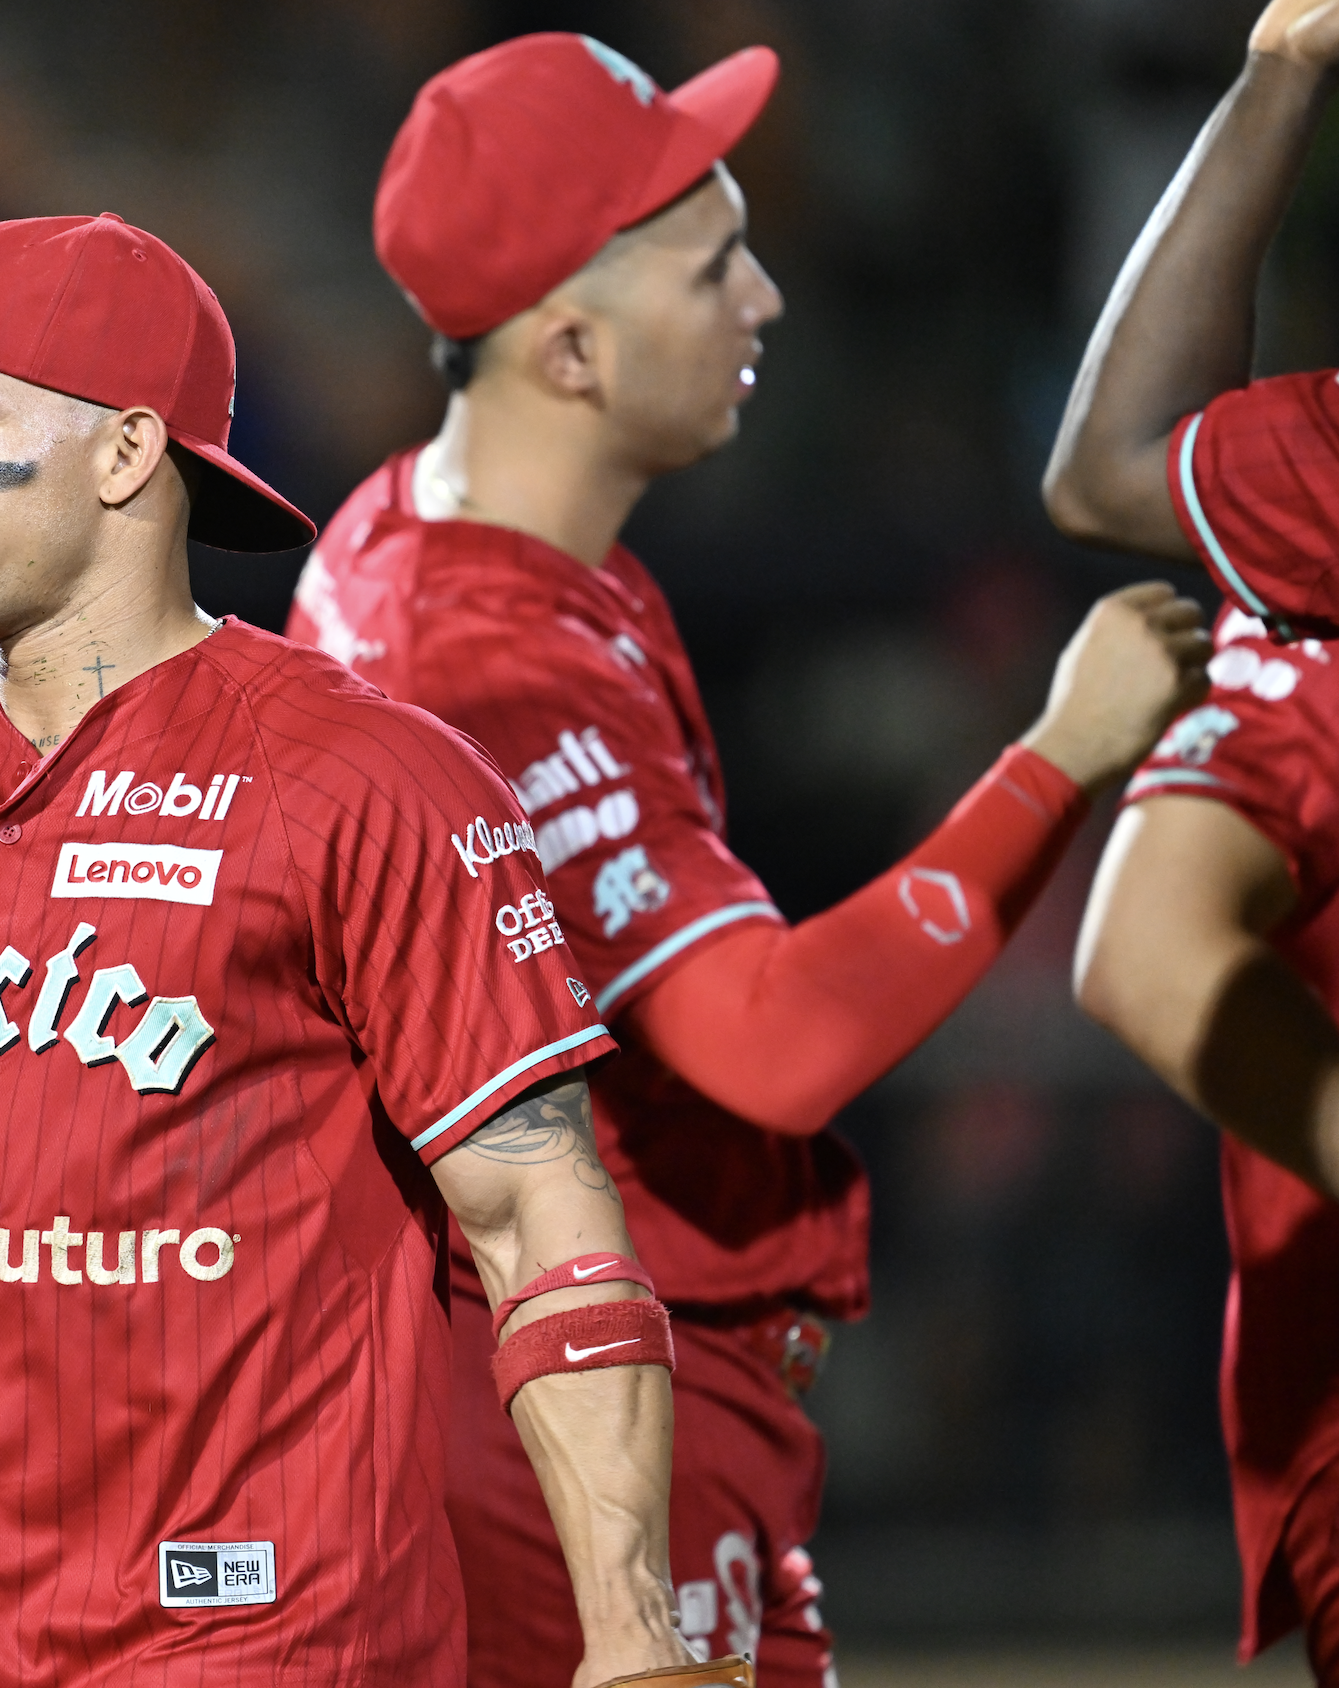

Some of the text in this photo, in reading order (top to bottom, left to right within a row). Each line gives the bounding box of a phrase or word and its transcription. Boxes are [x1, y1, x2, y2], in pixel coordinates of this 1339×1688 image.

[75, 769, 241, 821] Mobil
[66, 854, 203, 890] Lenovo
[207, 1543, 255, 1551] MERCHANDISE
[224, 1560, 260, 1573] NEW
[224, 1573, 260, 1586] ERA
[223, 1596, 248, 1604] JERSEY
